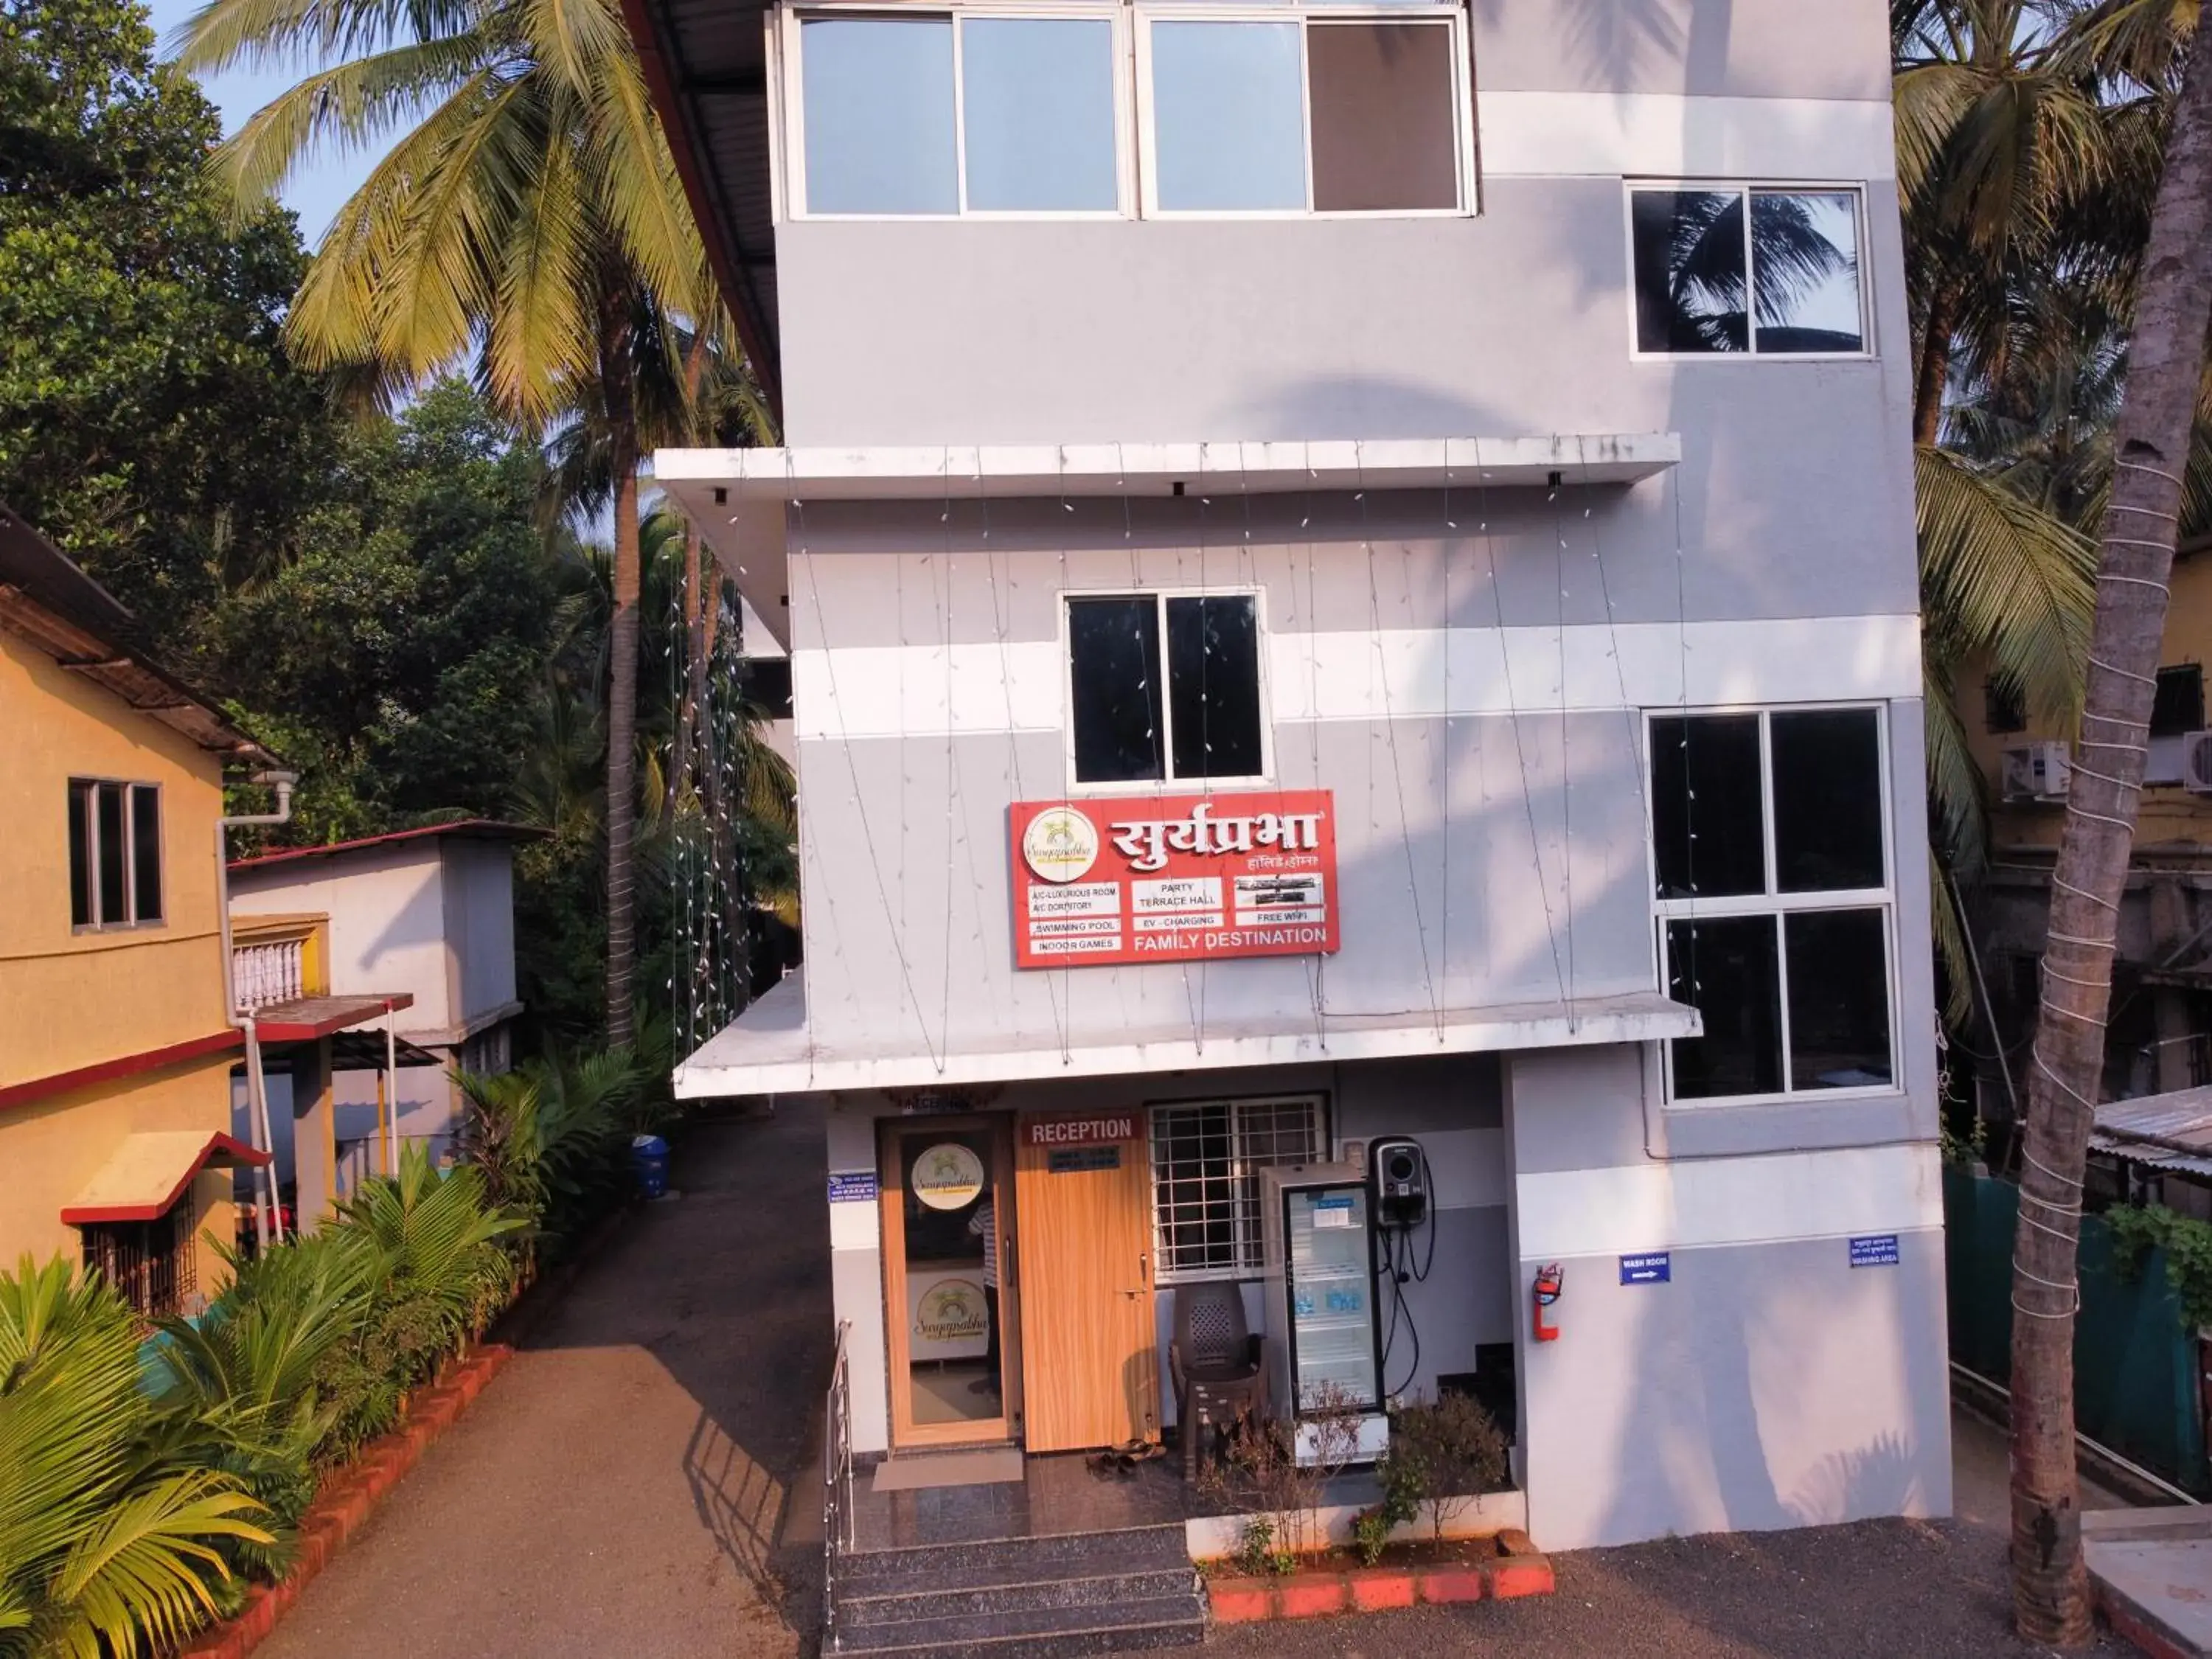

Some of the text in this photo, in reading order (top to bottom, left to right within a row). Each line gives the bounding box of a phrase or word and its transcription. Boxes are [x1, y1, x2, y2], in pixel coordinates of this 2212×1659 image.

[1093, 888, 1116, 896] ROOM
[1161, 883, 1194, 893] PARTY
[1140, 896, 1215, 907] TERRACE HALL
[1144, 919, 1155, 928] EV
[1164, 917, 1214, 927] CHARGING
[1257, 914, 1282, 922] FREE
[1036, 921, 1115, 933] SWIMMING POOL
[1039, 939, 1113, 950] INDOOR GAMES
[1134, 928, 1326, 951] FAMILY DESTINATION
[1032, 1119, 1132, 1143] RECEPTION
